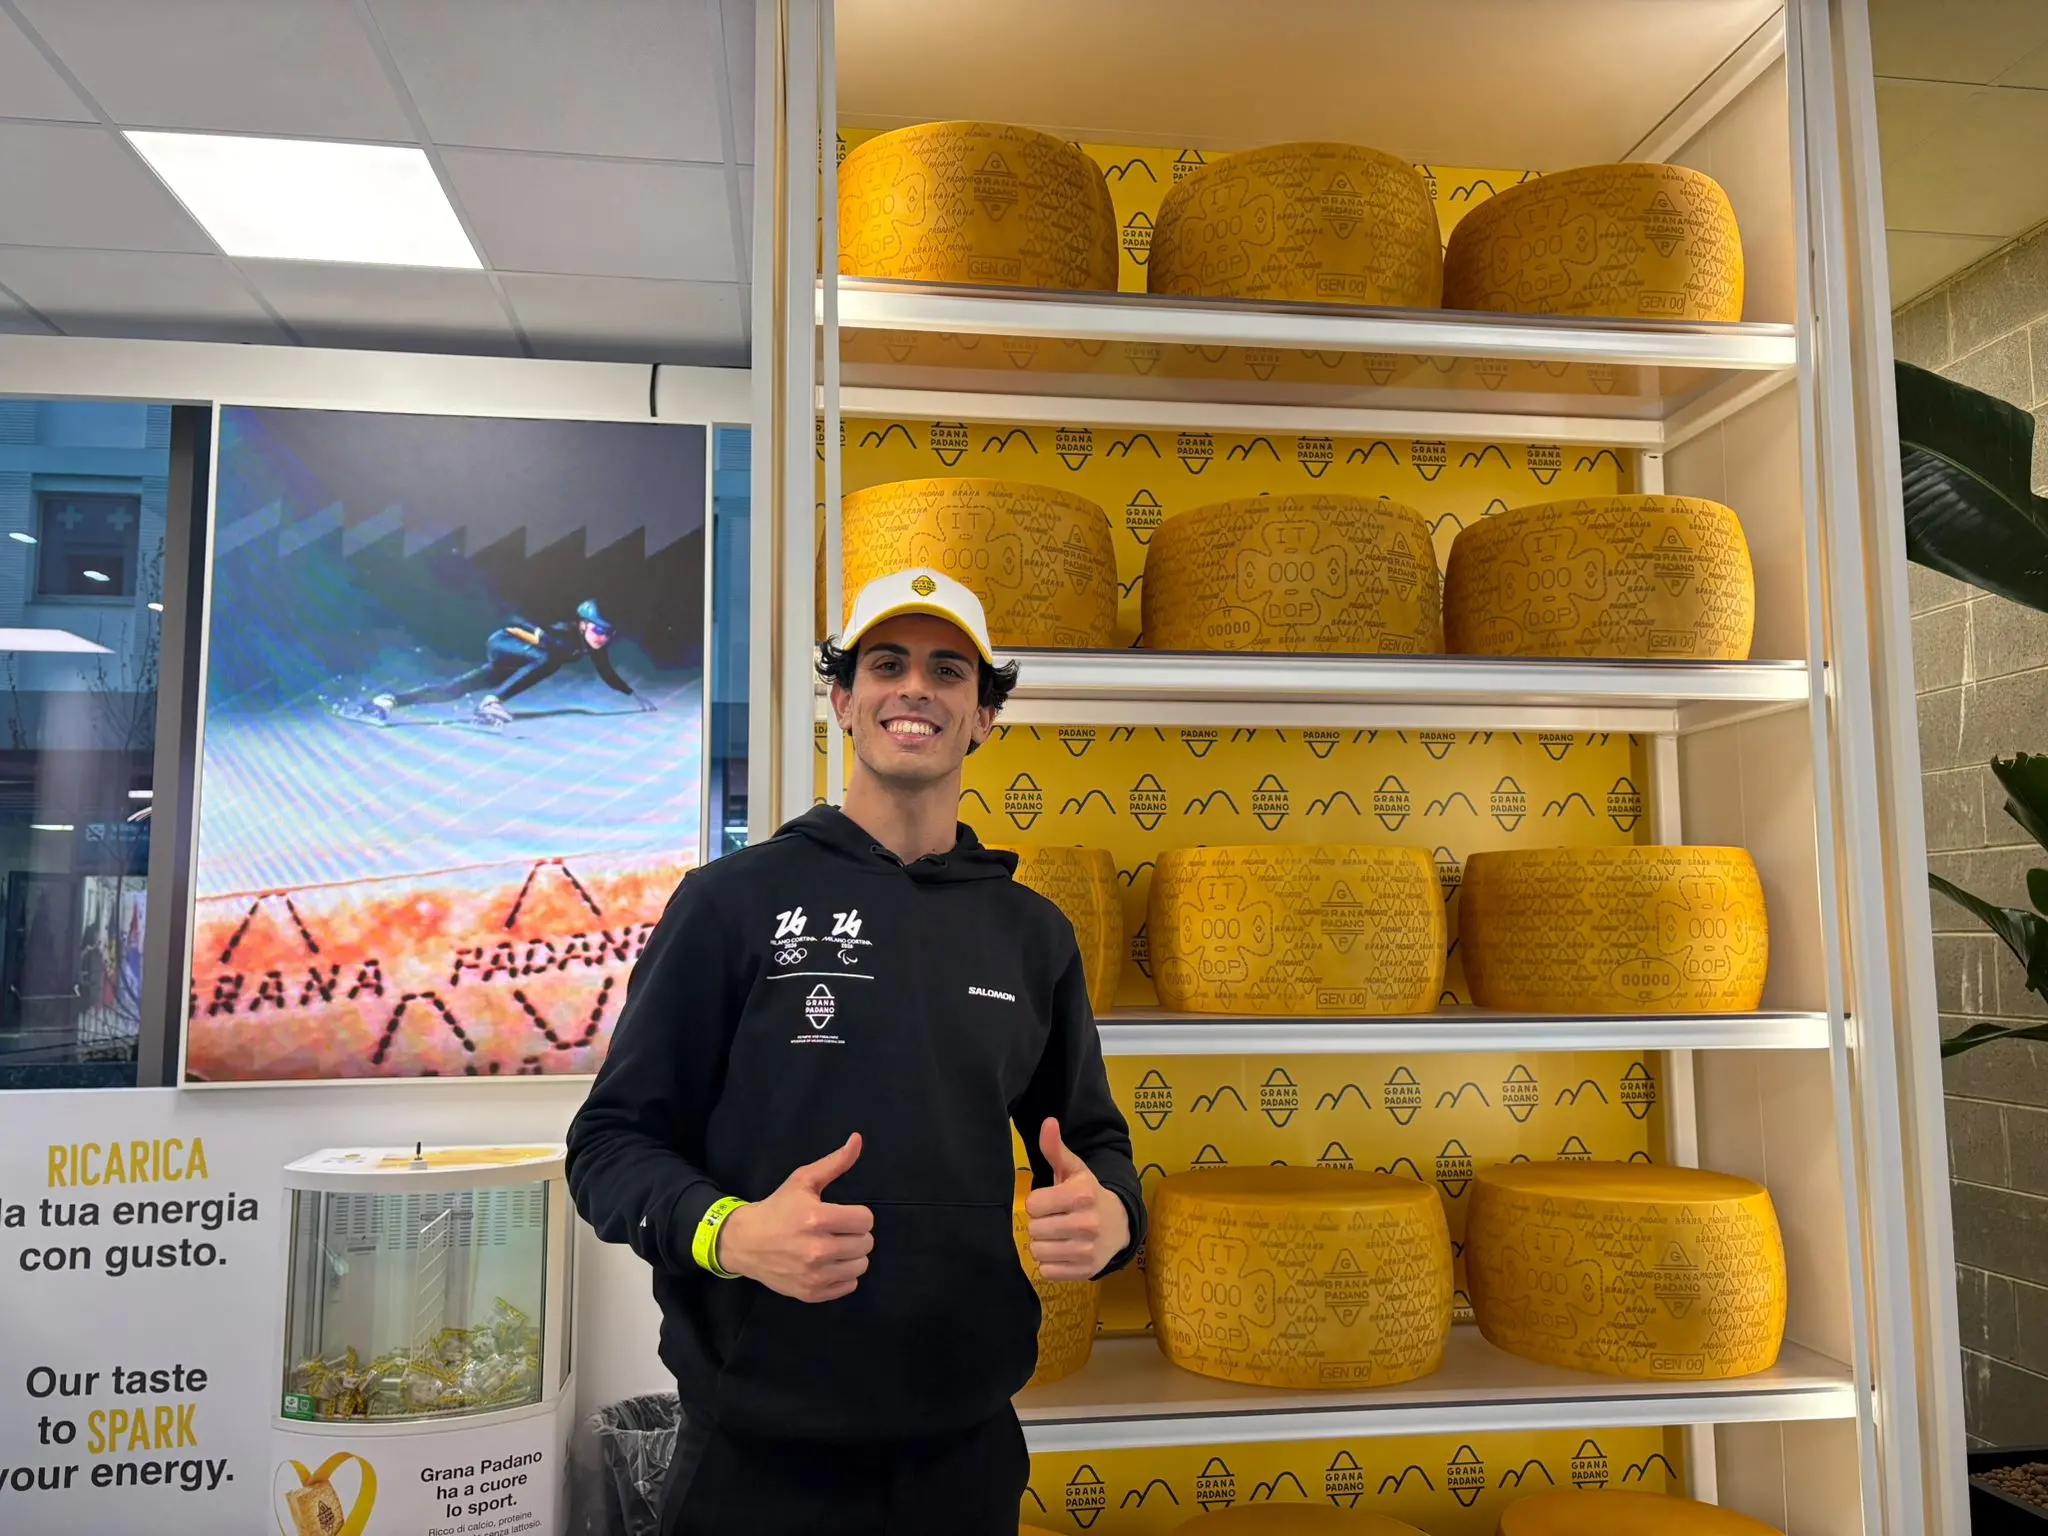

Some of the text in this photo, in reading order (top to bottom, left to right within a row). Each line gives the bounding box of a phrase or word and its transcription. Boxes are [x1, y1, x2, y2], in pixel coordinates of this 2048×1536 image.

[1122, 229, 1152, 238] GRAN
[1122, 239, 1151, 247] PADAN
[970, 261, 999, 274] GEN
[1319, 278, 1345, 291] GEN
[1641, 296, 1665, 308] GEN
[931, 429, 968, 439] GRANA
[1056, 434, 1092, 443] GRANA
[930, 439, 968, 448] PADANO
[1177, 438, 1213, 447] GRANA
[1297, 442, 1333, 451] GRANA
[1055, 443, 1093, 452] PADANO
[1177, 447, 1214, 456] PADANO
[1412, 446, 1446, 454] GRANA
[1297, 451, 1334, 460] PADANO
[1412, 454, 1447, 463] PADANO
[1527, 450, 1561, 458] GRANA
[1527, 458, 1562, 467] PADANO
[1126, 508, 1162, 517] GRANA
[1126, 517, 1163, 525] PADANO
[1380, 637, 1399, 651] GEN
[1651, 635, 1676, 648] GEN
[1058, 729, 1096, 738] PADANO
[1181, 729, 1218, 738] PADANO
[1303, 731, 1340, 740] PADANO
[1420, 732, 1455, 741] PADANO
[1538, 733, 1574, 742] PADANO
[1005, 793, 1042, 801] GRANA
[1130, 794, 1166, 802] GRANA
[1252, 794, 1288, 802] GRANA
[1374, 795, 1409, 803] GRANA
[1490, 796, 1525, 804] GRANA
[1607, 796, 1641, 804] GRANA
[1005, 802, 1043, 811] PADANO
[1129, 802, 1167, 811] PADANO
[1252, 803, 1289, 811] PADANO
[1373, 804, 1410, 812] PADANO
[1490, 805, 1526, 813] PADANO
[1607, 805, 1642, 813] PADANO
[968, 986, 1016, 1002] SALOMON
[1319, 992, 1345, 1005] GEN
[1502, 1084, 1538, 1093] GRANA
[1620, 1082, 1655, 1090] GRANA
[1134, 1091, 1172, 1100] GRANA
[1260, 1088, 1297, 1097] GRANA
[1384, 1087, 1421, 1096] GRANA
[1620, 1091, 1656, 1100] PADANO
[1260, 1098, 1298, 1107] PADANO
[1384, 1096, 1422, 1105] PADANO
[1502, 1094, 1539, 1102] PADANO
[1134, 1100, 1173, 1109] PADANO
[48, 1137, 208, 1187] RICARICA
[1436, 1160, 1471, 1169] GRANA
[1317, 1163, 1353, 1171] GRANA
[1436, 1169, 1473, 1178] PADANO
[0, 1192, 258, 1230] a tua energia
[20, 1239, 226, 1277] con gusto.
[1653, 1358, 1681, 1370] GEN
[1321, 1367, 1350, 1380] GEN
[26, 1364, 208, 1398] Our taste
[38, 1403, 198, 1454] to SPARK
[421, 1451, 542, 1482] Grana Padano
[1571, 1460, 1608, 1470] GRANA
[91, 1459, 233, 1491] energy.
[1447, 1466, 1484, 1476] GRANA
[1571, 1470, 1608, 1480] PADANO
[1325, 1472, 1363, 1481] GRANA
[1447, 1476, 1485, 1486] PADANO
[437, 1473, 528, 1500] ha a cuore
[1197, 1479, 1235, 1489] GRANA
[1325, 1482, 1364, 1492] PADANO
[1066, 1486, 1105, 1496] GRANA
[1197, 1489, 1236, 1499] PADANO
[446, 1493, 517, 1518] lo sport.
[1066, 1497, 1106, 1506] PADANO
[457, 1523, 466, 1533] di
[467, 1521, 496, 1531] calcio,
[498, 1511, 532, 1526] proteine
